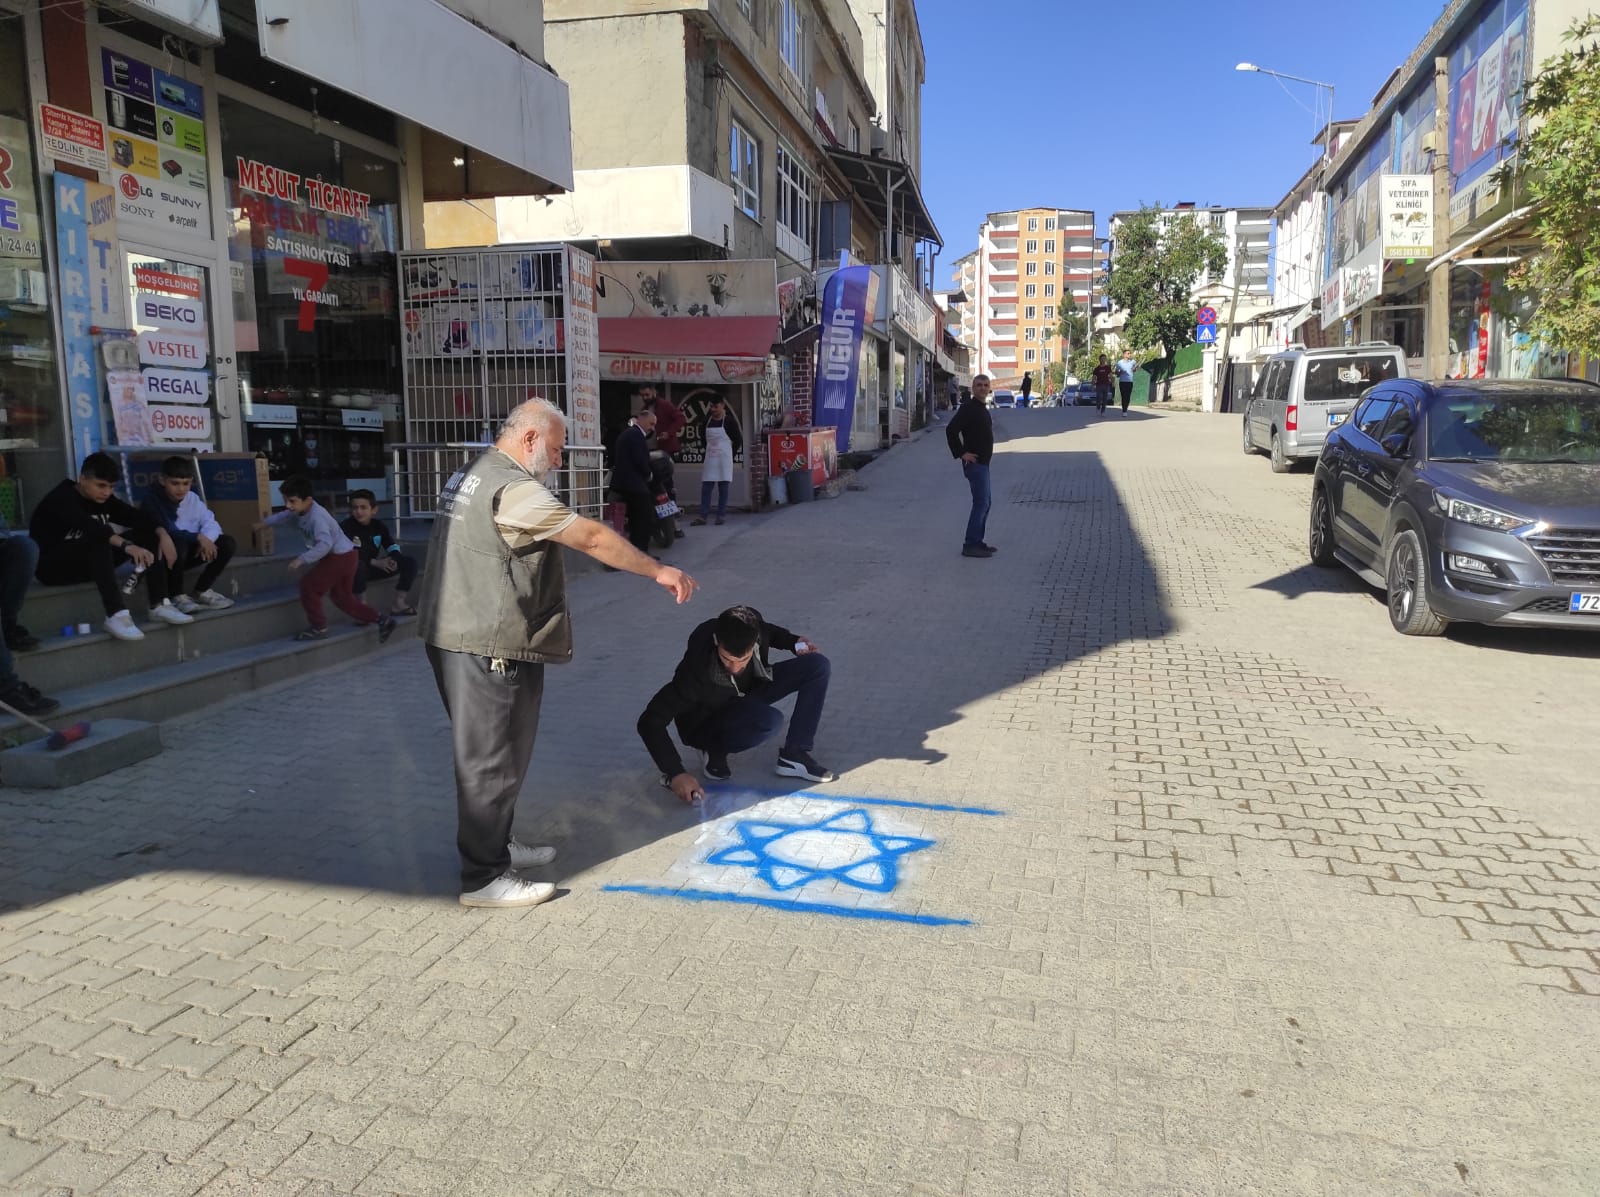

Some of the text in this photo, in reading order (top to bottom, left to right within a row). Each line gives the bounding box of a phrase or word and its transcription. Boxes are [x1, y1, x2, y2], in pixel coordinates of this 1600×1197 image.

[140, 186, 202, 210] LG SUNNY
[236, 155, 300, 204] MESUT
[305, 173, 370, 222] TİCARET
[1388, 188, 1429, 198] VETERİNER
[120, 202, 155, 219] SONY
[7, 239, 21, 252] 24
[25, 241, 37, 256] 41
[137, 273, 199, 292] HOŞGELDİNİZ
[283, 256, 329, 332] 7
[291, 287, 306, 301] YIL
[144, 302, 196, 323] BEKO
[148, 340, 199, 360] VESTEL
[609, 355, 661, 377] GÜVEN
[147, 376, 203, 396] REGAL
[167, 414, 205, 430] BOSCH
[682, 454, 703, 462] 0530
[1581, 595, 1600, 610] 72
